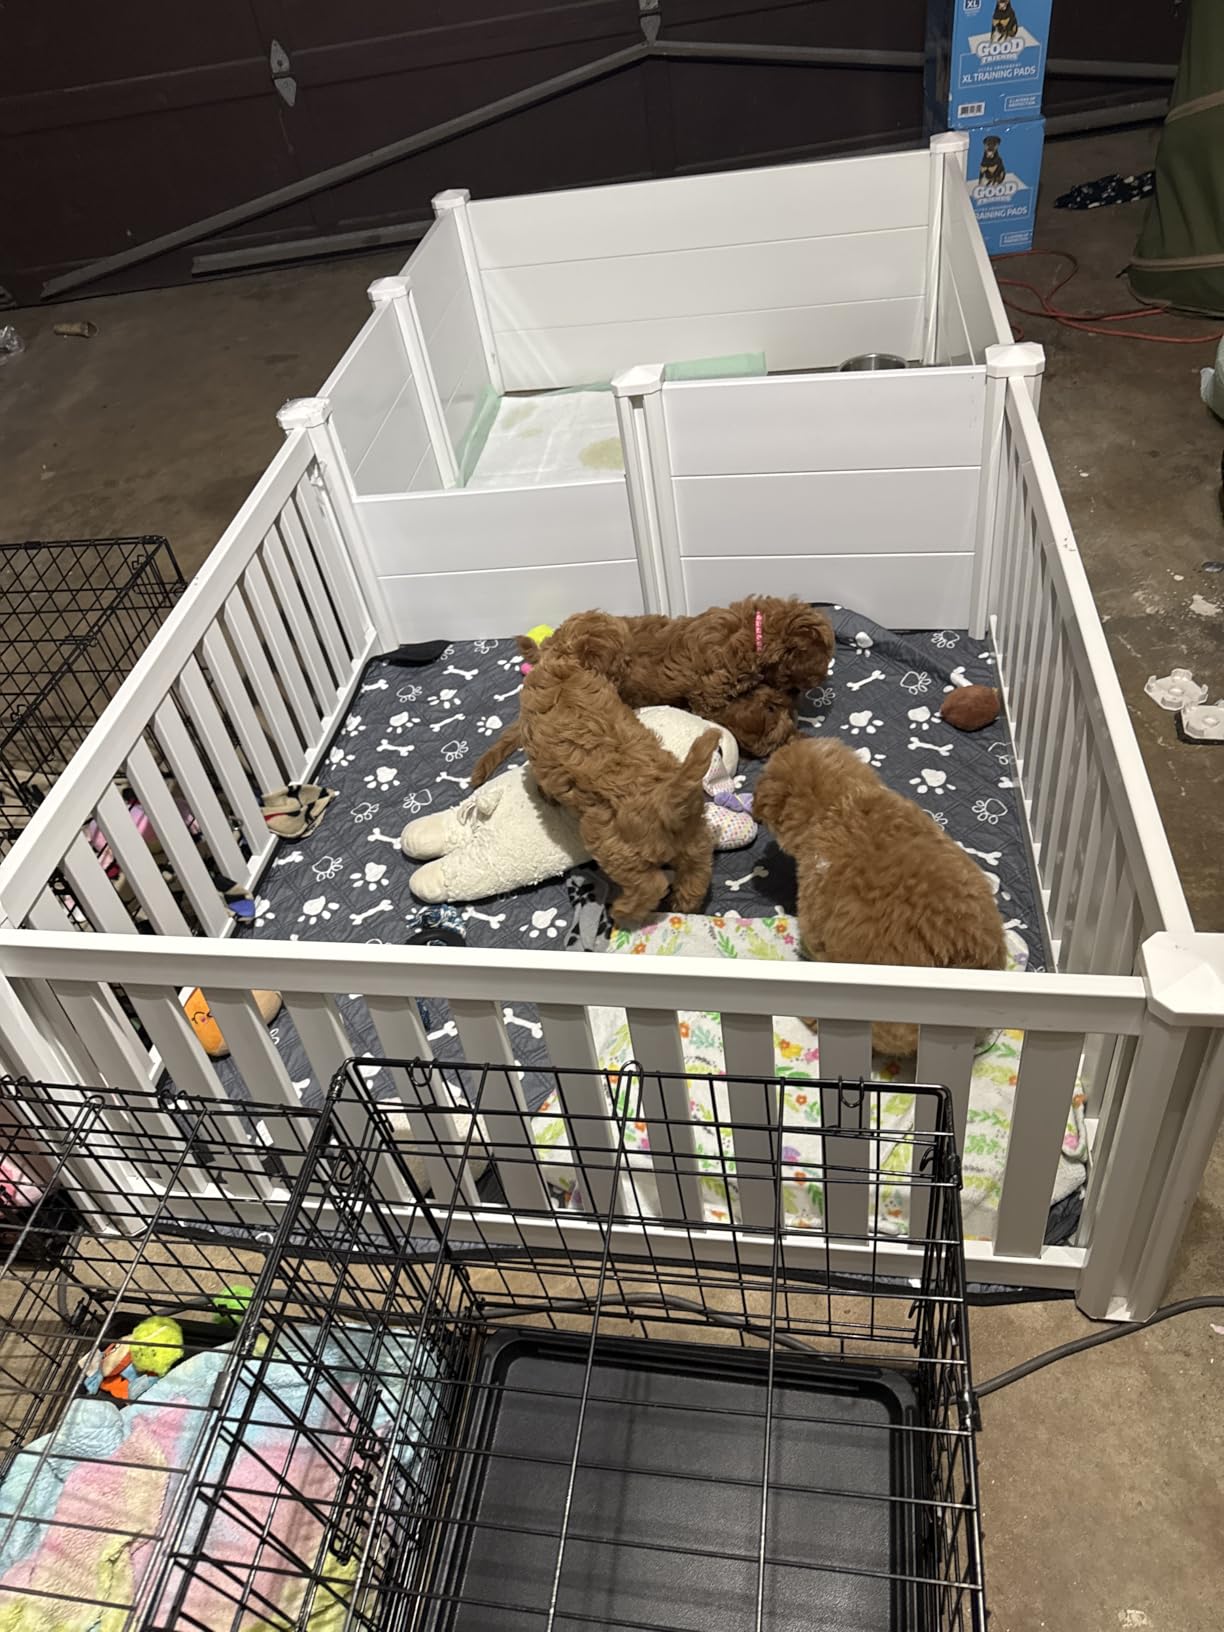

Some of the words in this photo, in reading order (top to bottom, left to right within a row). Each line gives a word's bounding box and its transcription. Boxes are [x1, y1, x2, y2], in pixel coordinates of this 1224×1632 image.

[966, 0, 978, 8] XL
[978, 40, 1024, 56] GOOD
[961, 75, 973, 83] XL
[974, 70, 1013, 81] TRAINING
[1013, 66, 1036, 76] PADS
[974, 182, 1017, 199] GOOD
[975, 211, 1006, 220] RAINING
[1006, 207, 1028, 216] PADS
